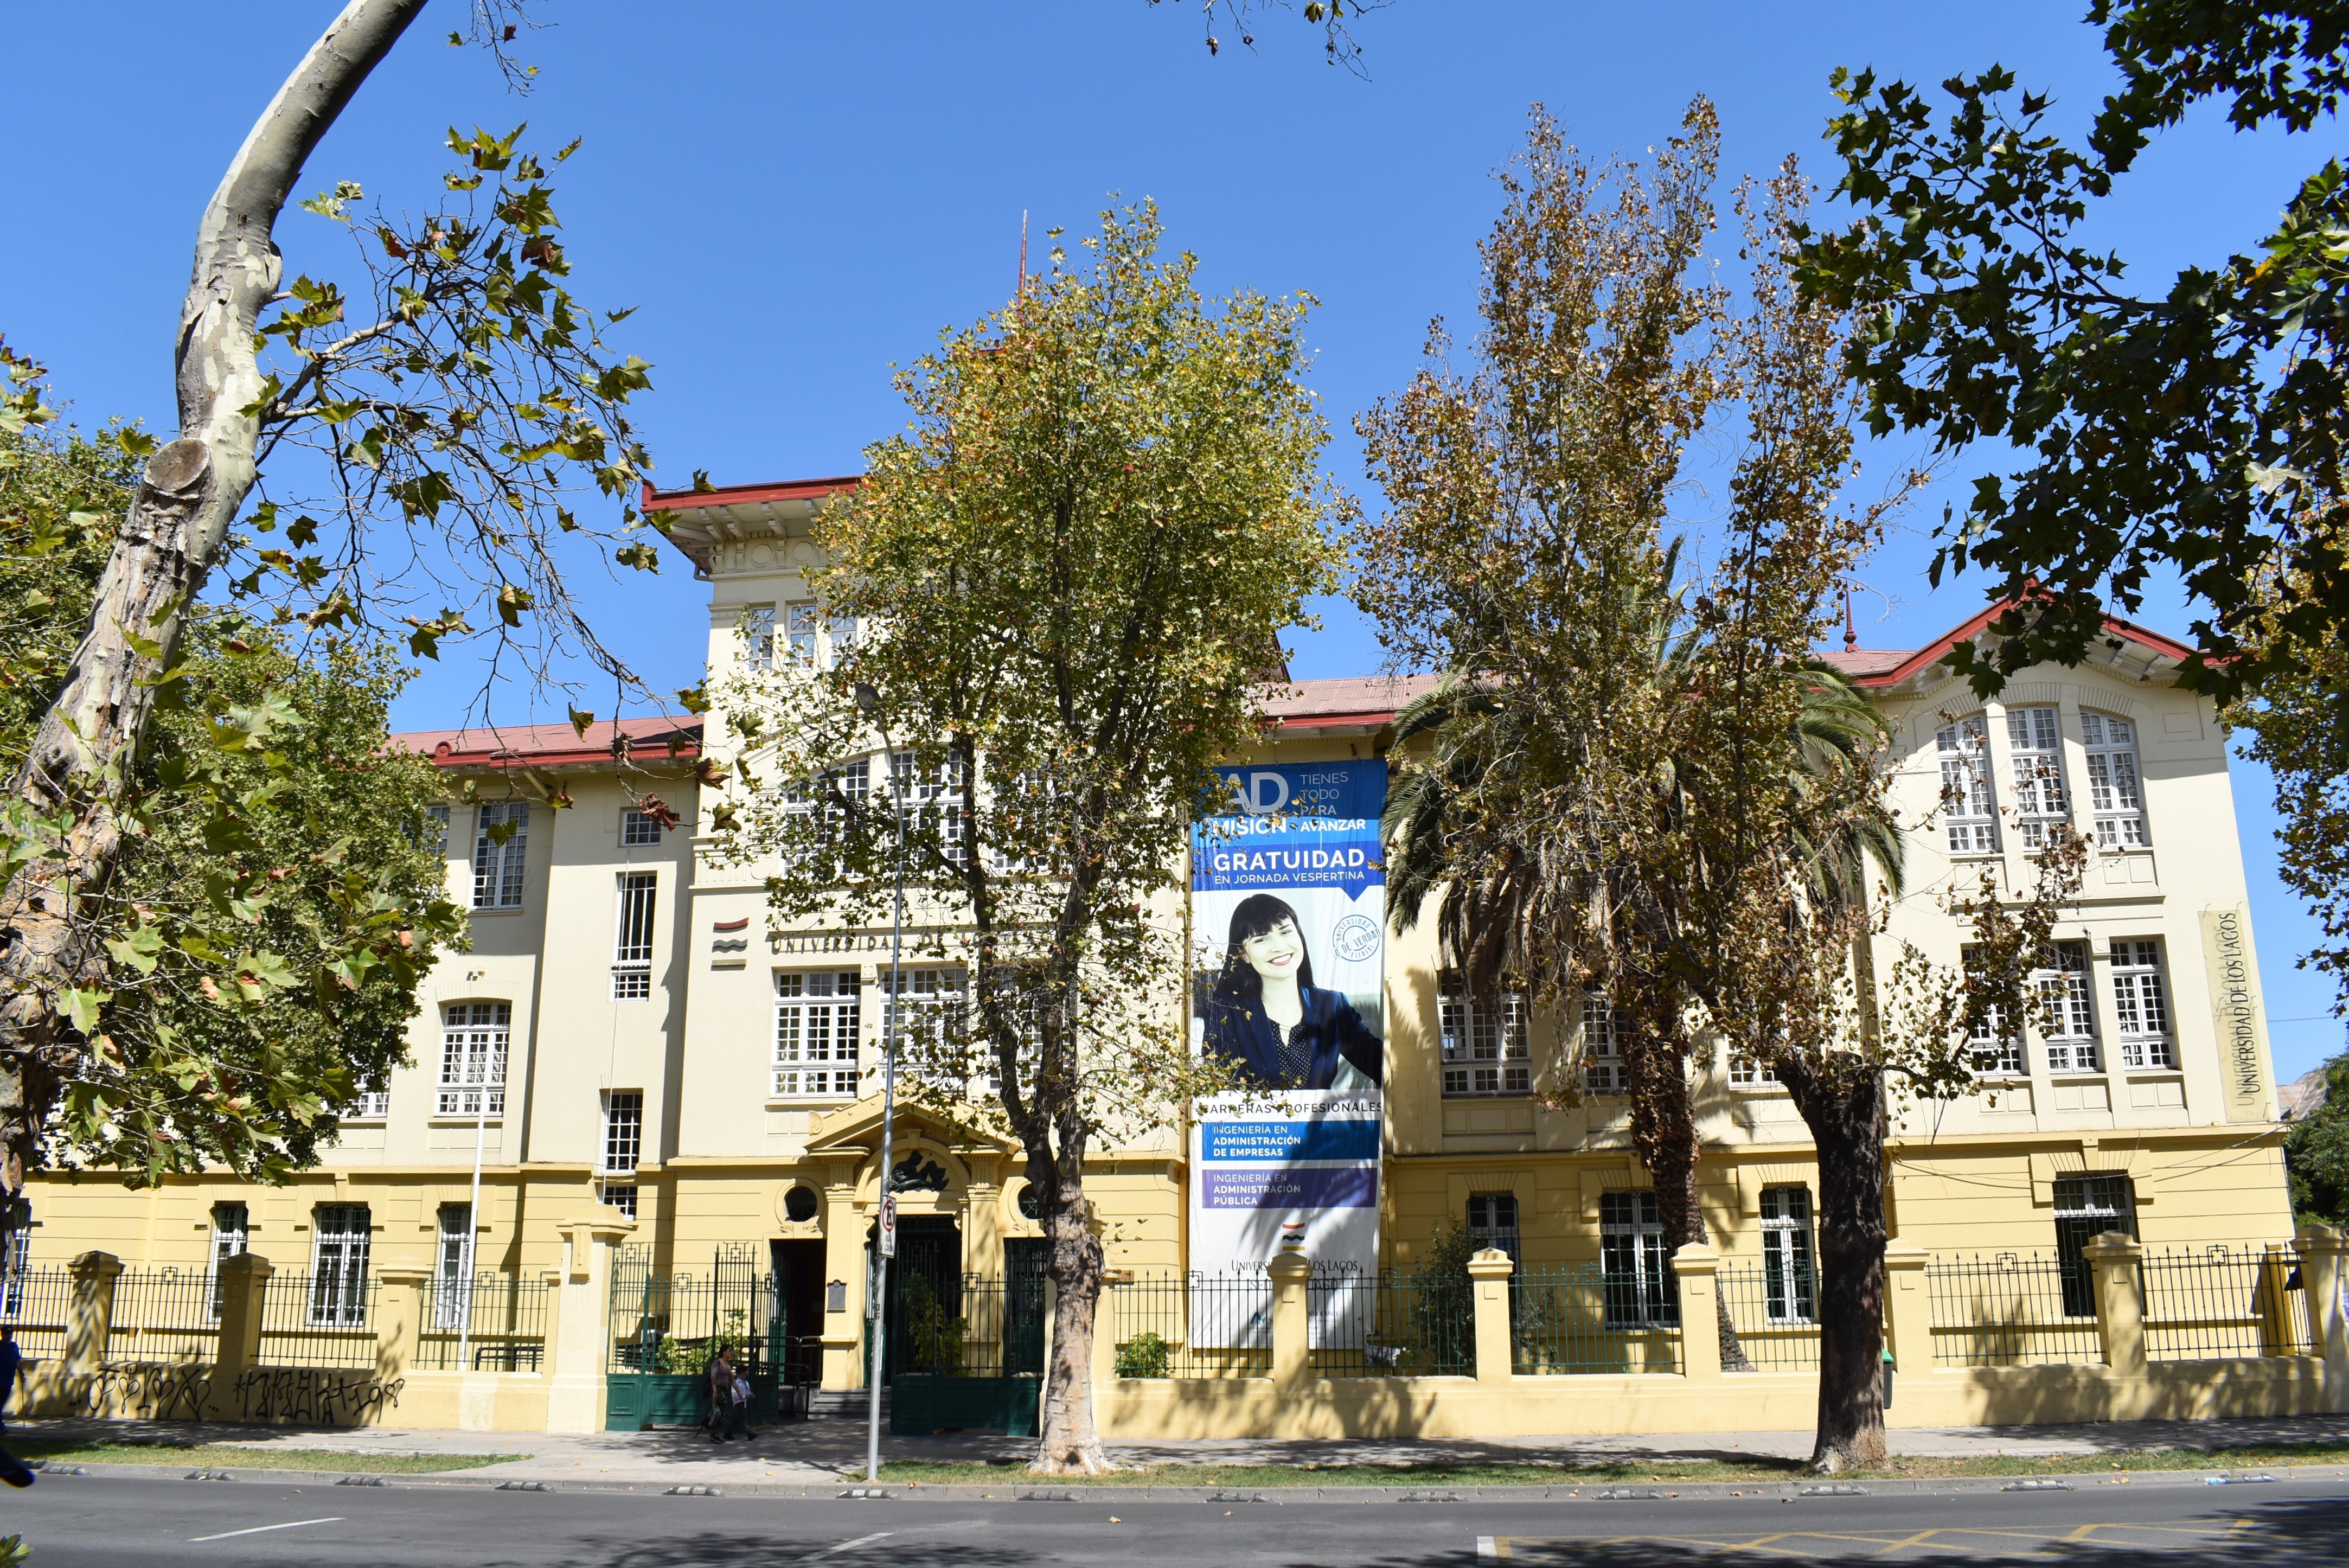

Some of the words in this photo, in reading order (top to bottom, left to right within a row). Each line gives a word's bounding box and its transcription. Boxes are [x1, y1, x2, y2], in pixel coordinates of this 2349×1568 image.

[1300, 772, 1348, 785] TIENES
[1300, 789, 1339, 801] TODO
[1301, 804, 1337, 816] PARA
[1300, 818, 1366, 832] AVANZAR
[1214, 849, 1365, 871] GRATUIDAD
[1215, 875, 1230, 884] EN
[1233, 873, 1290, 884] JORNADA
[1292, 871, 1365, 882] VESPERTINA
[1341, 942, 1352, 953] DE
[1353, 928, 1381, 947] VERDAD
[2219, 912, 2242, 957] LAGOS
[1350, 945, 1375, 959] ESTATAL
[2226, 959, 2246, 983] LOS
[2230, 986, 2249, 1004] DE
[2233, 1006, 2261, 1095] UNIVERSIDAD
[1213, 1124, 1271, 1134] INGENIERÍA
[1275, 1125, 1288, 1134] EN
[1213, 1135, 1301, 1145] ADMINISTRACIÓN
[1214, 1148, 1227, 1156] DE
[1230, 1148, 1283, 1156] EMPRESAS
[1213, 1172, 1271, 1182] INGENIERÍA
[1275, 1174, 1287, 1182] EN
[1213, 1183, 1301, 1194] ADMINISTRACIÓN
[1214, 1195, 1258, 1205] PÚBLICA
[1328, 1258, 1358, 1271] LAGOS
